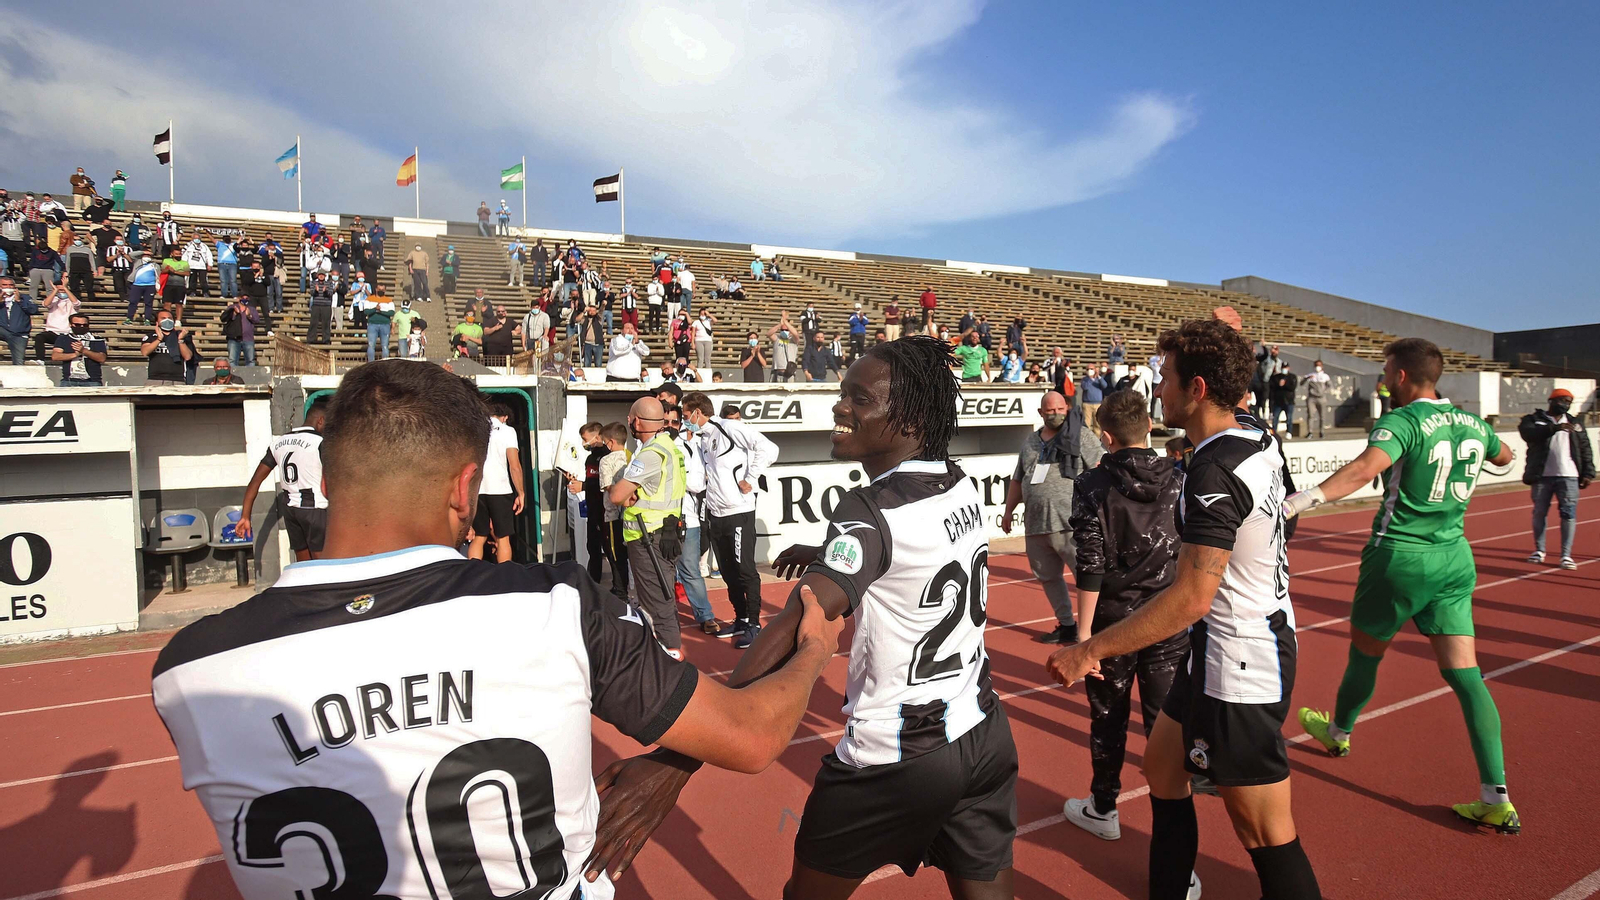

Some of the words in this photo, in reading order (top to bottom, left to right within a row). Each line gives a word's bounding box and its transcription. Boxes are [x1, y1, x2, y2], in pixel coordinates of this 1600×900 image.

[957, 397, 1024, 416] EGEA
[281, 450, 299, 486] 6
[1427, 438, 1485, 503] 13
[943, 503, 983, 545] CHAM
[733, 526, 743, 564] LEGEA
[0, 594, 47, 623] ES
[271, 669, 474, 767] LOREN
[232, 737, 568, 900] 30
